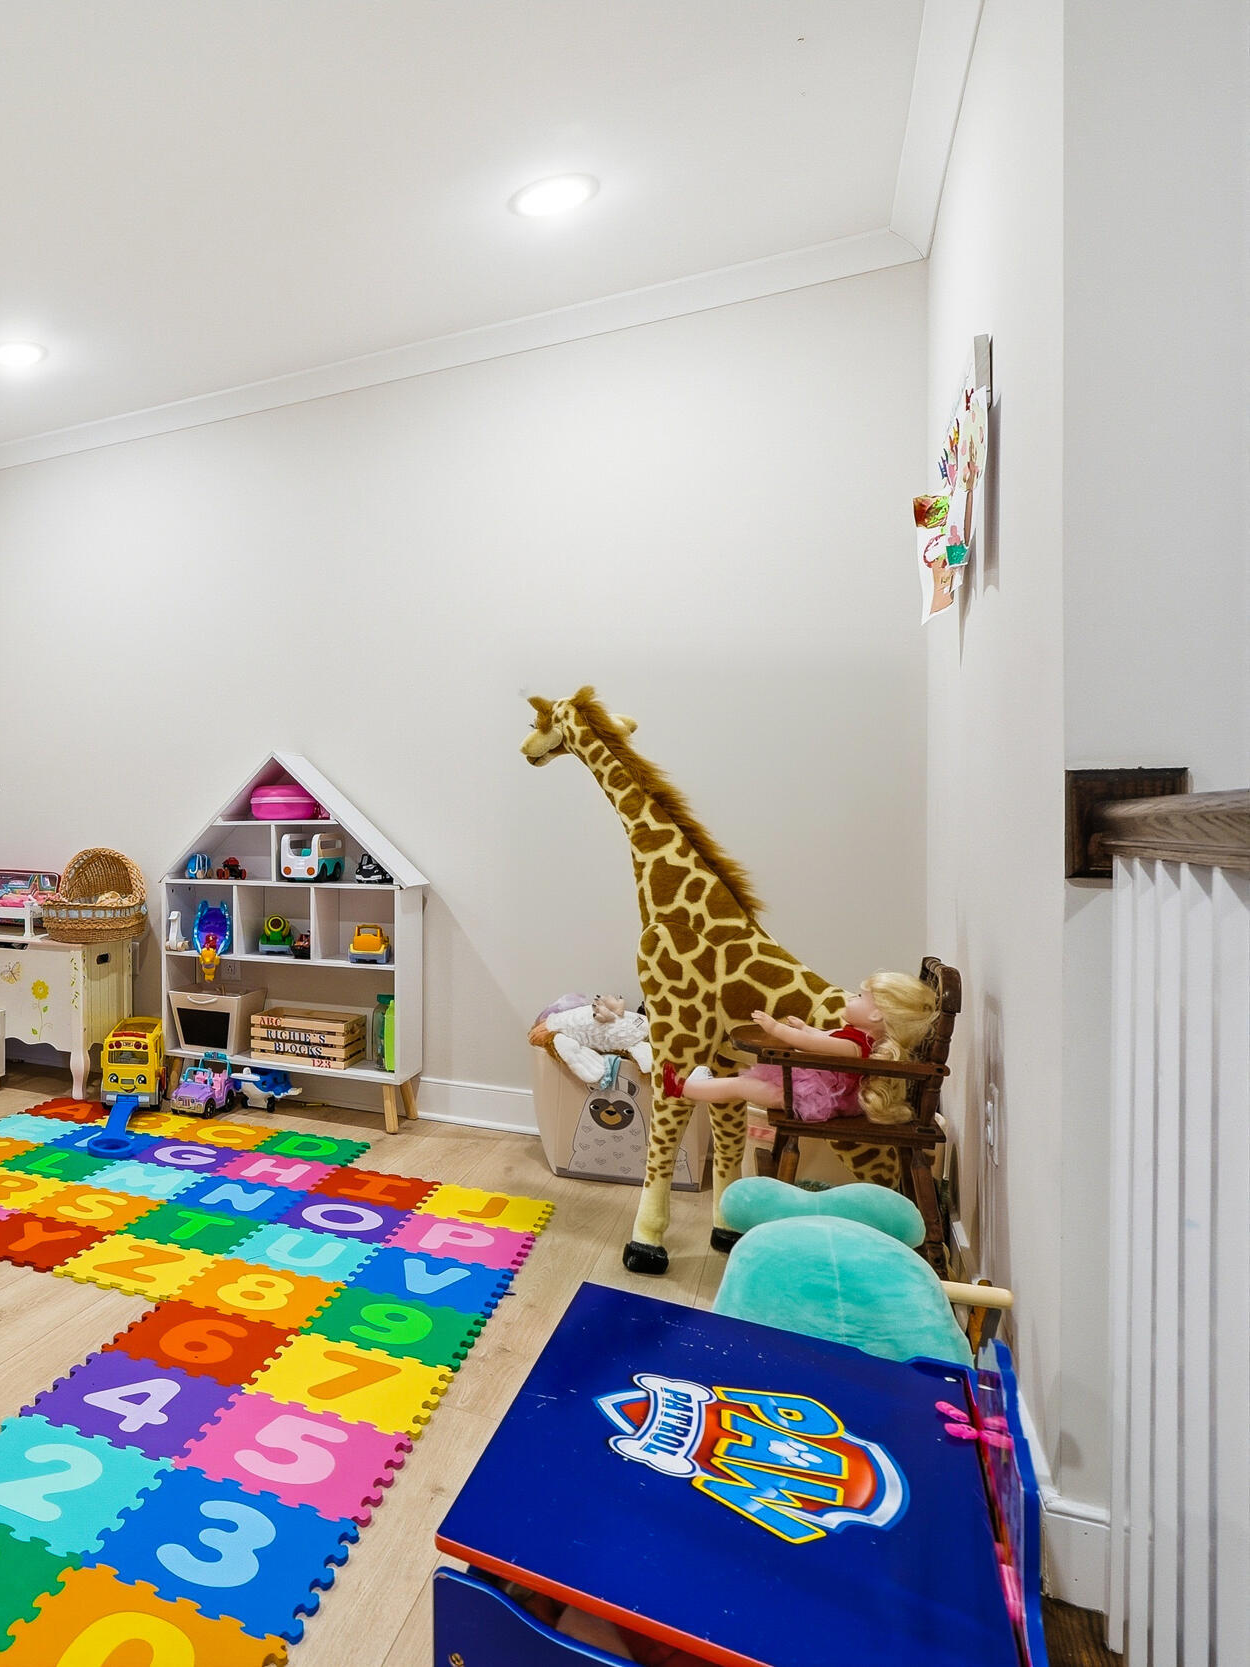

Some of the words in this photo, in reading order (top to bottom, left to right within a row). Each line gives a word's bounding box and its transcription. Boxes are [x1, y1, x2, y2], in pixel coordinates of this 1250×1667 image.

[259, 1016, 283, 1027] ABC
[266, 1029, 327, 1044] RICHIE'S
[273, 1041, 323, 1056] BLOCKS
[311, 1058, 332, 1069] 123
[41, 1103, 94, 1120] A
[197, 1125, 256, 1144] C
[272, 1135, 339, 1157] D
[26, 1152, 70, 1174] L
[96, 1165, 186, 1195] M
[199, 1183, 276, 1211] N
[301, 1203, 384, 1231] O
[418, 1223, 495, 1250] P
[154, 1145, 217, 1166] G
[240, 1158, 312, 1183] H
[337, 1174, 412, 1201] I
[457, 1197, 510, 1218] J
[7, 1221, 82, 1252] Y
[92, 1245, 186, 1283] Z
[57, 1194, 128, 1220] S
[169, 1211, 235, 1240] T
[265, 1233, 347, 1267] U
[404, 1258, 471, 1294] V
[217, 1273, 294, 1311] 8
[350, 1303, 434, 1345] 9
[159, 1319, 248, 1364] 6
[306, 1350, 402, 1401] 7
[82, 1378, 182, 1432] 4
[234, 1415, 349, 1485] 5
[643, 1385, 692, 1457] PATROL
[691, 1385, 849, 1545] PAW
[155, 1500, 277, 1589] 3
